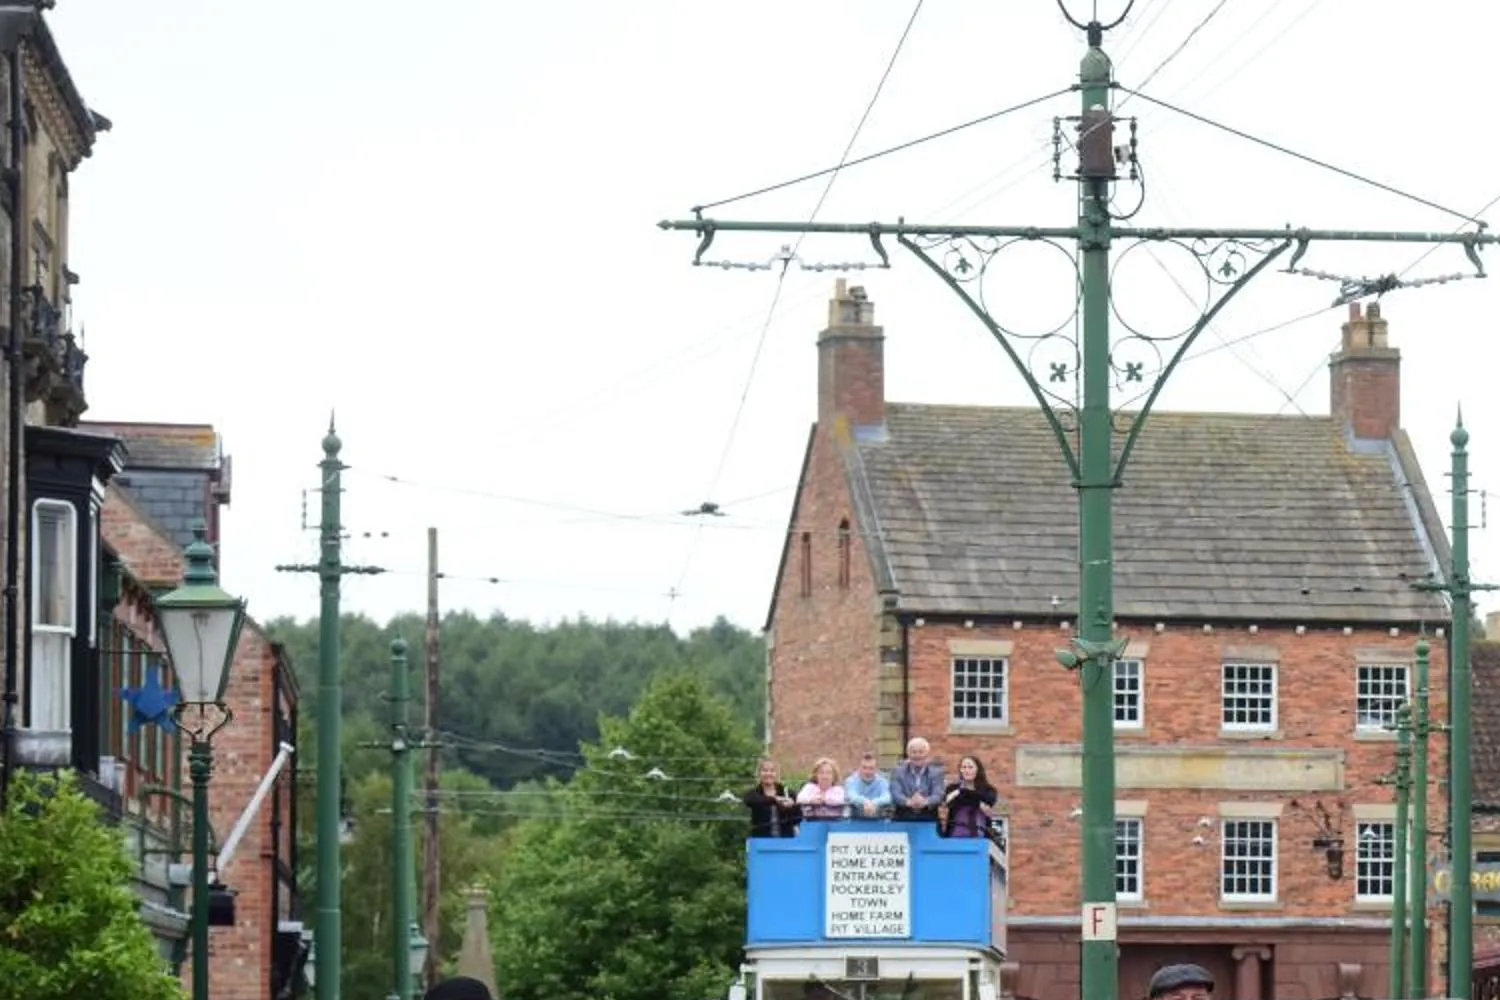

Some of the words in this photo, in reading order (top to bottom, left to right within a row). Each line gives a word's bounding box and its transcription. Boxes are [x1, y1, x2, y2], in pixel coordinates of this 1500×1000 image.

[831, 845, 849, 854] PIT
[855, 845, 905, 854] VILLAGE
[831, 858, 867, 868] HOME
[871, 858, 904, 868] FARM
[834, 871, 900, 881] ENTRANCE
[831, 885, 904, 894] POCKERLEY
[850, 898, 887, 908] TOWN
[831, 911, 865, 921] HOME
[870, 911, 903, 921] FARM
[1092, 906, 1106, 937] F
[831, 924, 848, 933] PIT
[853, 924, 905, 934] VILLAGE
